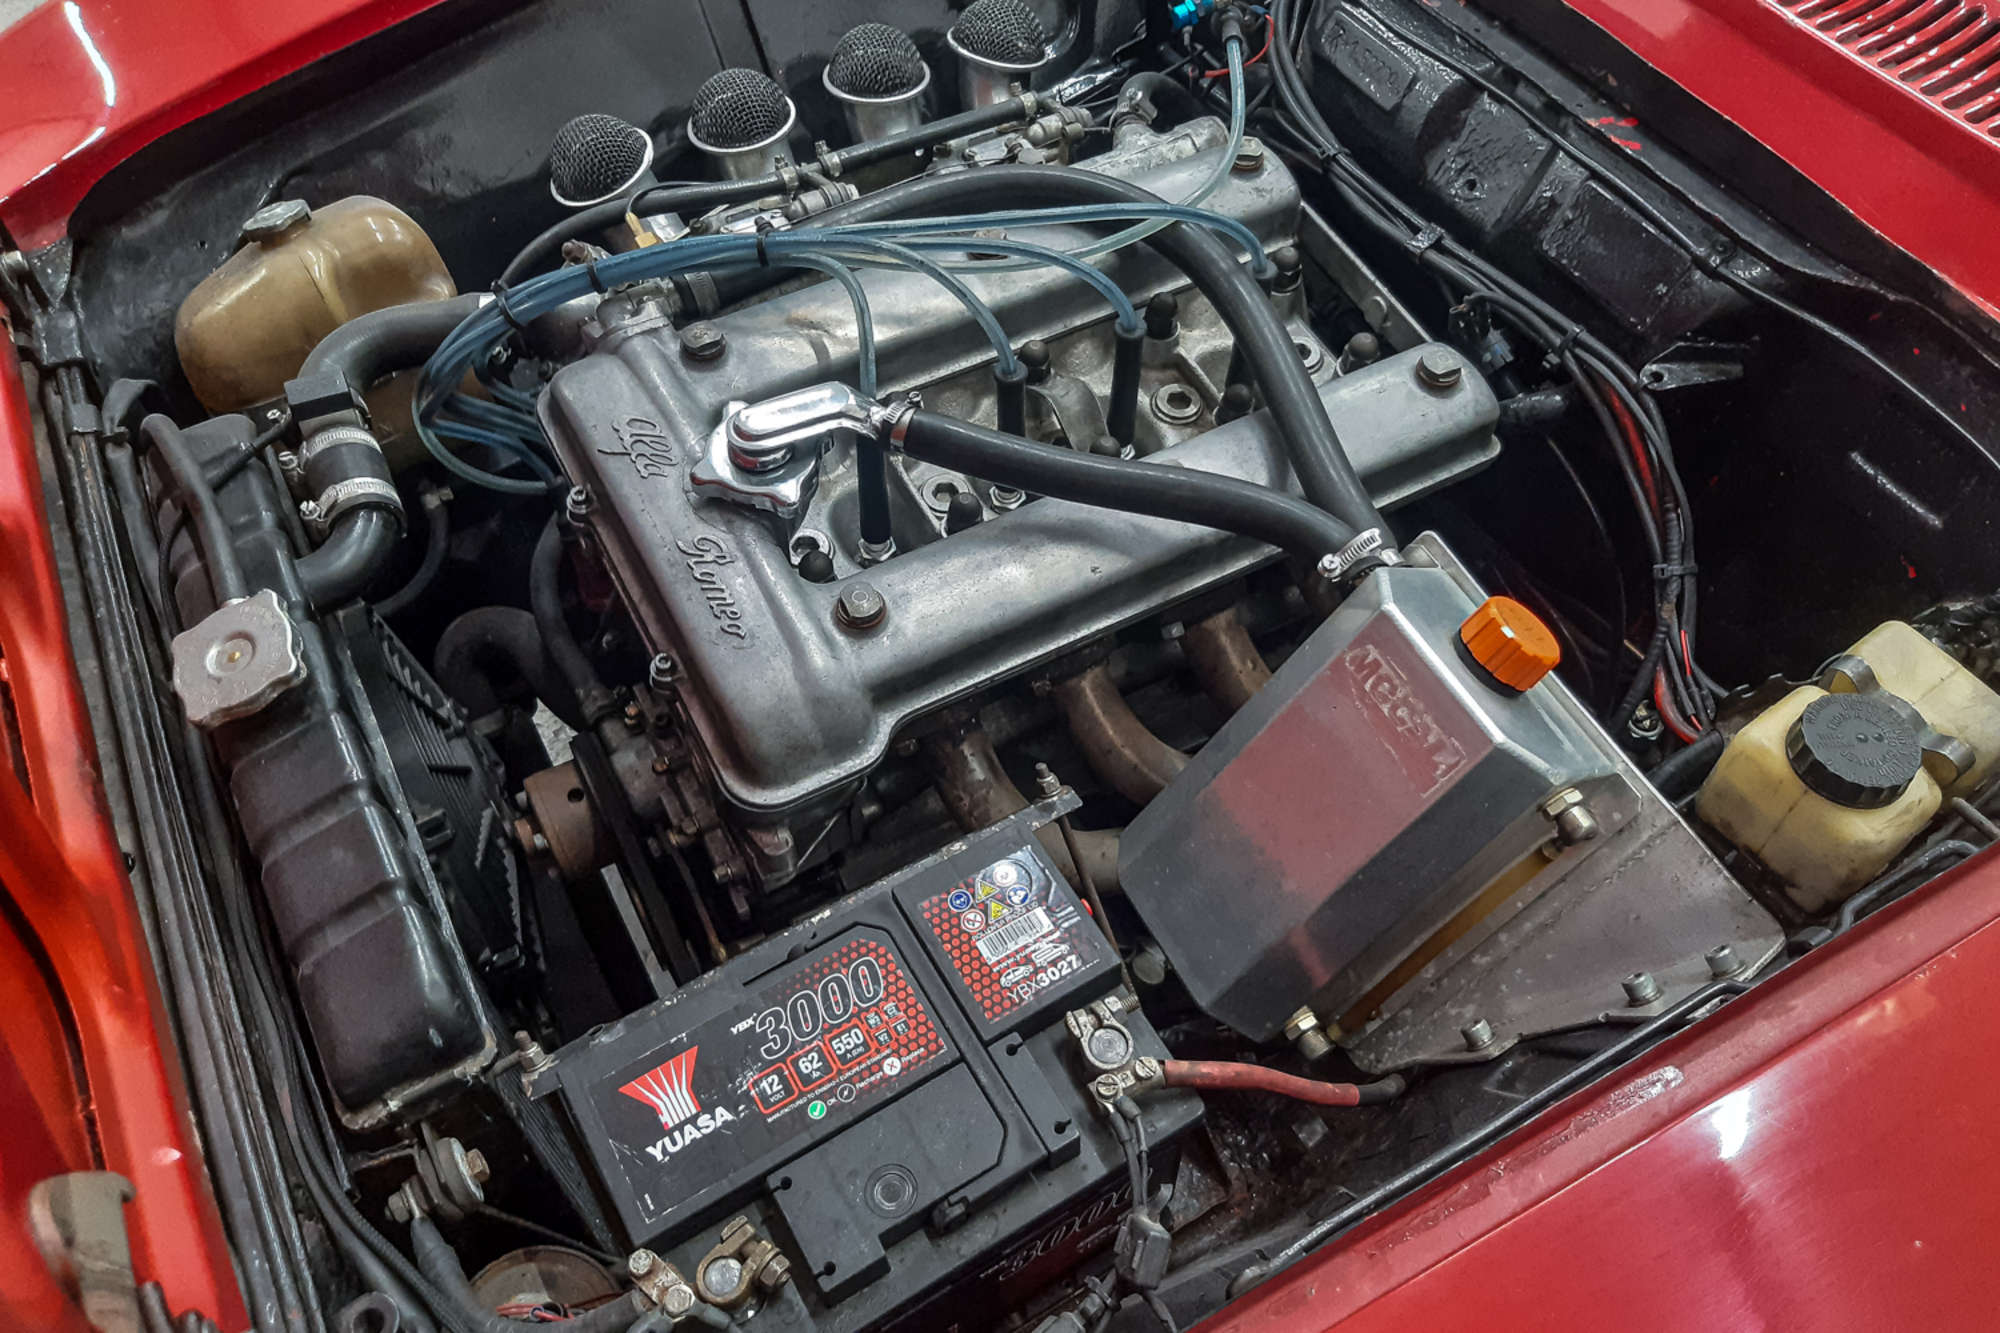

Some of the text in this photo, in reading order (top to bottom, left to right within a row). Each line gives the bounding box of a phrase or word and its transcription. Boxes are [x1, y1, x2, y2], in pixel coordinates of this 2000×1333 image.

[597, 417, 747, 640] Alfa Romeo
[1007, 954, 1080, 1003] YBX3027
[730, 957, 884, 1060] YBX 3000
[831, 1028, 864, 1055] 550
[798, 1052, 823, 1074] 62
[760, 1074, 783, 1096] 12
[769, 1090, 785, 1103] VOLT
[826, 1097, 838, 1106] OK
[645, 1106, 734, 1162] YUASA
